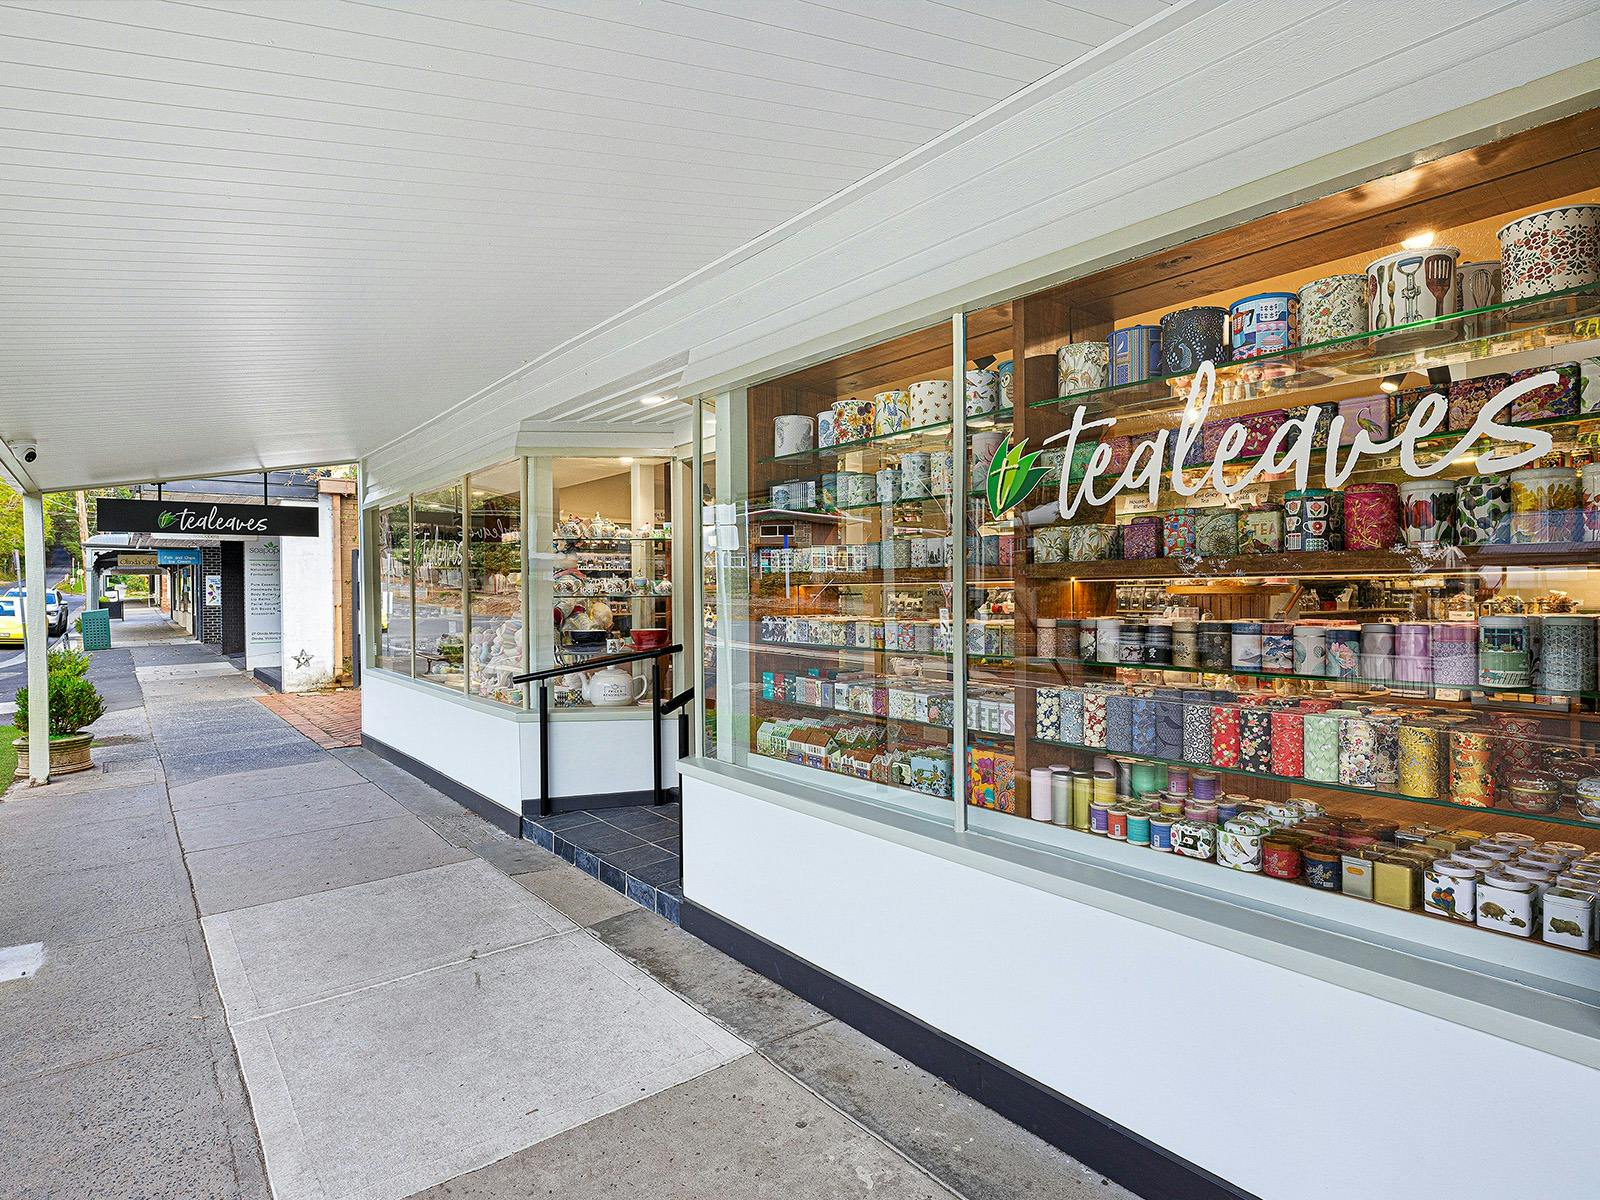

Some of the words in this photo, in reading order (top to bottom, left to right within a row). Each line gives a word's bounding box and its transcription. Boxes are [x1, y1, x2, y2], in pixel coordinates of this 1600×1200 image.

[1042, 361, 1559, 520] tealeaves
[176, 505, 268, 531] tealeaves
[1251, 521, 1278, 536] TEA
